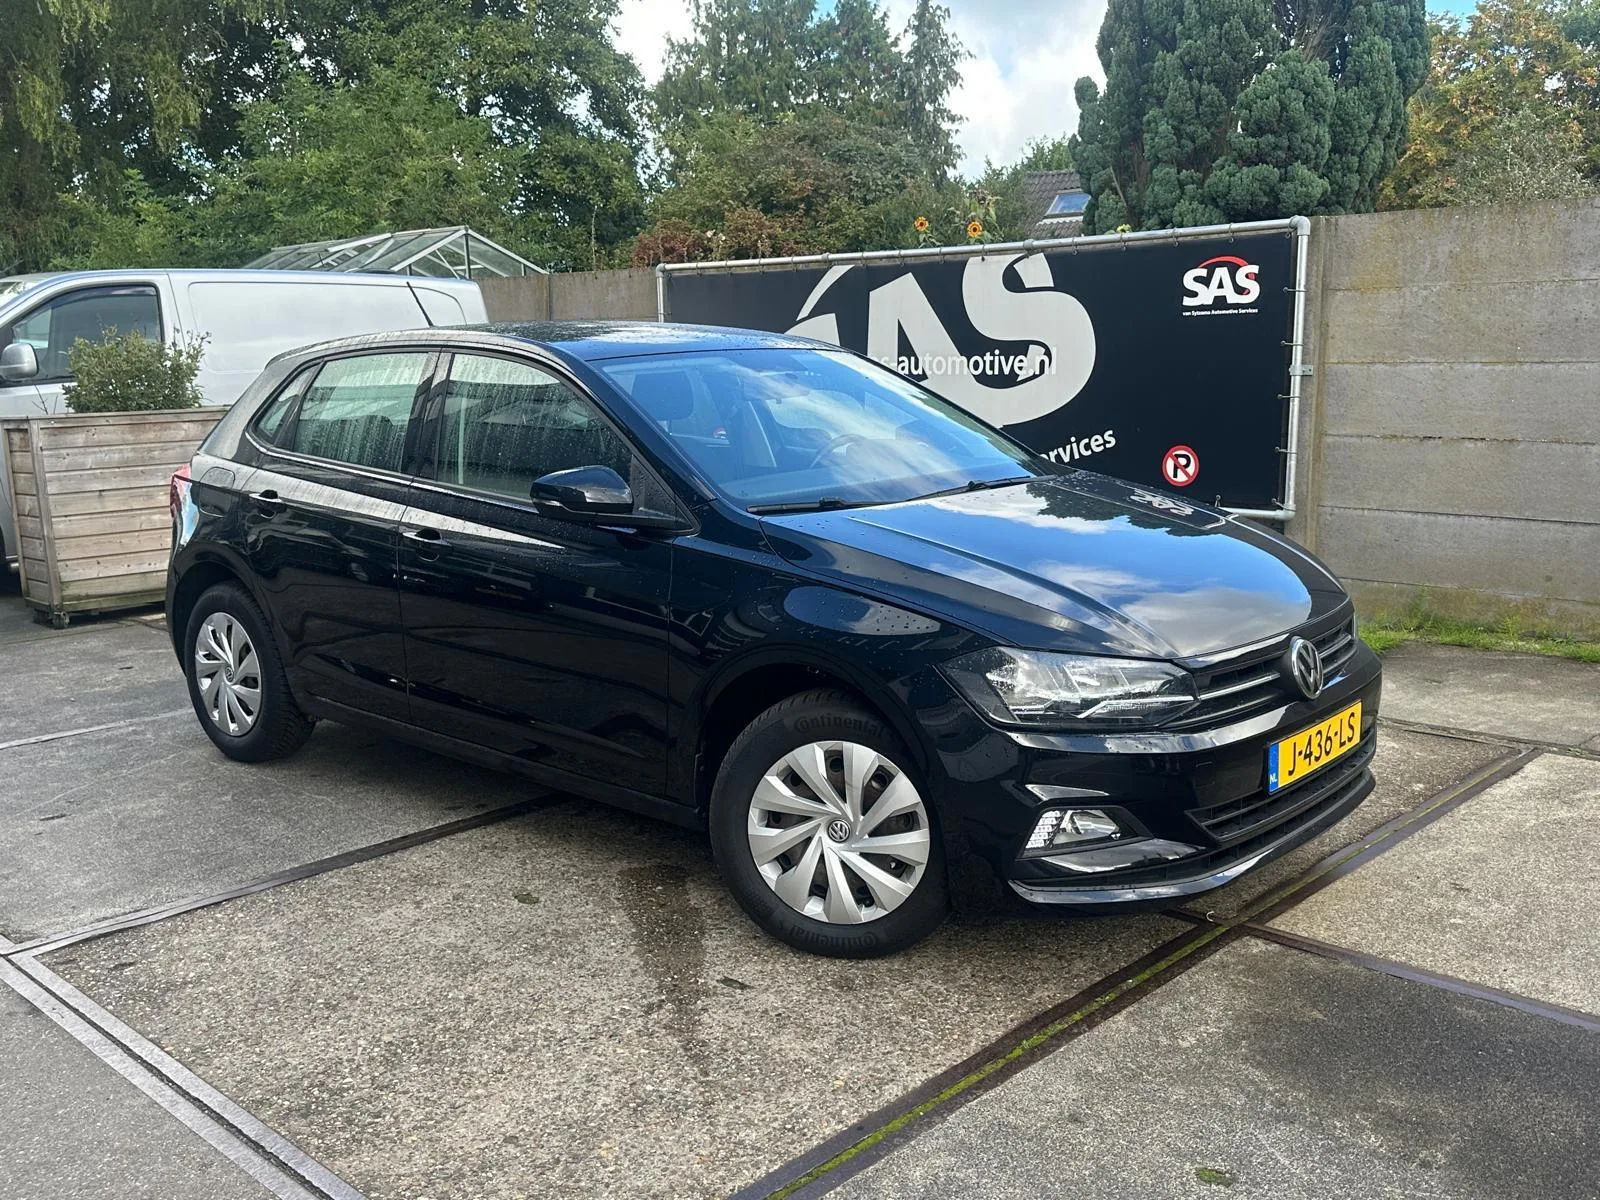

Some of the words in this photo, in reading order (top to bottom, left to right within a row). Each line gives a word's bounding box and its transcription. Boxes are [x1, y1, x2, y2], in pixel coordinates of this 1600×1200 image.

[1182, 264, 1260, 306] SAS
[783, 252, 1096, 428] AS
[870, 344, 1056, 376] -automotive.nl
[1039, 430, 1116, 463] rvices
[794, 712, 885, 738] Continental
[1288, 711, 1356, 777] J-436-LS
[1269, 772, 1278, 785] NL
